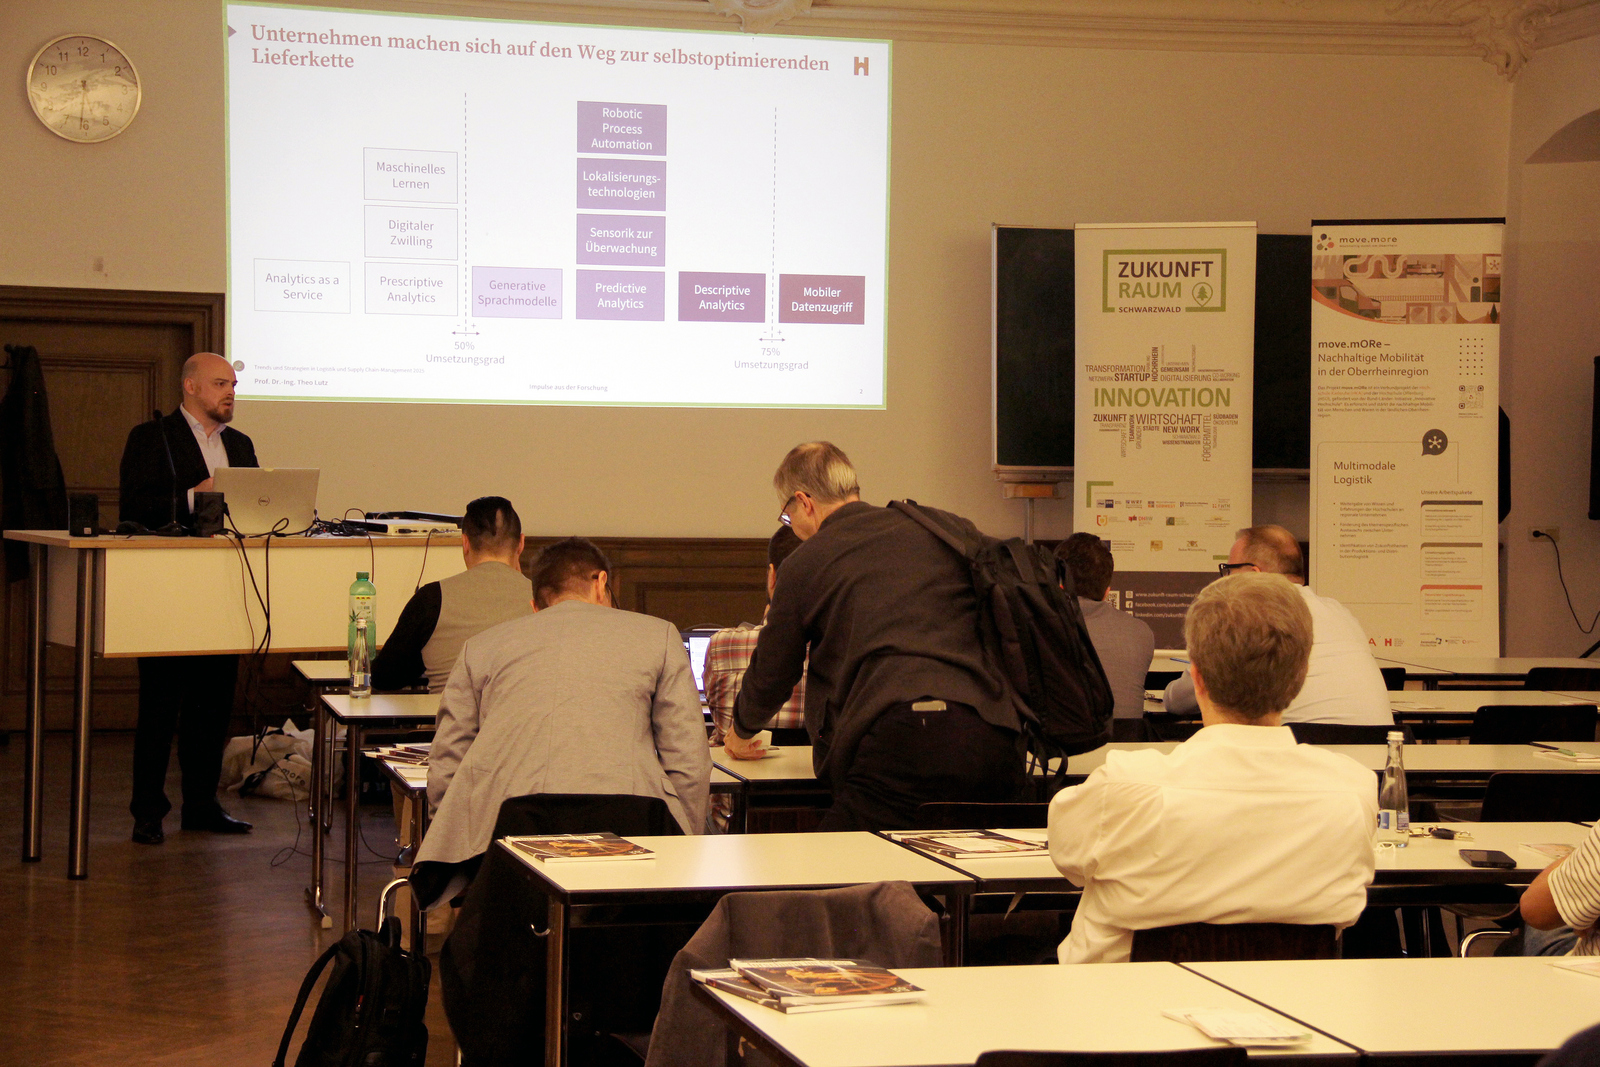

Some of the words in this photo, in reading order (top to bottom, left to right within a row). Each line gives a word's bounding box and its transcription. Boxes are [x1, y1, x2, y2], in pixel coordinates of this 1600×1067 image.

[78, 46, 89, 57] 12
[251, 24, 382, 48] Unternehmen
[388, 34, 461, 52] machen
[465, 38, 502, 55] sich
[506, 40, 537, 56] auf
[540, 42, 572, 58] den
[578, 44, 616, 65] Weg
[620, 50, 649, 64] zur
[653, 48, 830, 72] selbstoptimierenden
[58, 52, 68, 62] 11
[100, 54, 105, 63] 1
[252, 48, 354, 69] Lieferkette
[45, 66, 58, 76] 10
[114, 66, 121, 76] 2
[40, 82, 48, 92] 9
[122, 84, 128, 95] 3
[63, 114, 70, 124] 7
[602, 106, 642, 120] Robotic
[82, 120, 90, 130] 6
[102, 116, 110, 126] 5
[602, 122, 642, 135] Process
[591, 138, 653, 150] Automation
[376, 161, 446, 175] Maschinelles
[392, 178, 430, 190] Lernen
[583, 170, 660, 186] Lokalisierungs-
[588, 186, 655, 200] technologien
[388, 219, 434, 233] Digitaler
[590, 227, 634, 239] Sensorik
[636, 228, 653, 240] zur
[390, 235, 433, 249] Zwilling
[585, 242, 658, 257] Überwachung
[1118, 261, 1214, 278] ZUKUNFT
[265, 273, 316, 286] Analytics
[318, 276, 330, 285] as
[332, 277, 340, 285] a
[380, 276, 444, 291] Prescriptive
[489, 280, 546, 292] Generative
[595, 282, 647, 294] Predictive
[694, 284, 750, 298] Descriptive
[803, 286, 842, 298] Mobiler
[1119, 282, 1182, 298] RAUM
[282, 288, 323, 300] Service
[387, 292, 436, 304] Analytics
[478, 294, 558, 309] Sprachmodelle
[597, 297, 644, 310] Analytics
[699, 299, 745, 312] Analytics
[791, 302, 853, 314] Datenzugriff
[454, 340, 475, 351] 50%
[1318, 340, 1382, 349] move.mORe
[761, 347, 780, 357] 75%
[426, 354, 505, 366] Umsetzungsgrad
[1318, 353, 1376, 364] Nachhaltige
[1380, 353, 1424, 362] Mobilität
[734, 360, 809, 372] Umsetzungsgrad
[1085, 364, 1146, 372] TRANSFORMATION
[1318, 367, 1326, 376] in
[1329, 366, 1345, 376] der
[1347, 366, 1428, 378] Oberrheinregion
[272, 378, 296, 387] Dr.-Ing.
[1114, 373, 1150, 382] STARTUP
[1094, 387, 1230, 408] INNOVATION
[1093, 414, 1127, 422] ZUKUNFT
[1136, 414, 1202, 425] WIRTSCHAFT
[1202, 414, 1212, 462] FÖRDERMITTEL
[1334, 461, 1396, 470] Multimodale
[1334, 474, 1372, 486] Logistik
[1384, 638, 1392, 646] H
